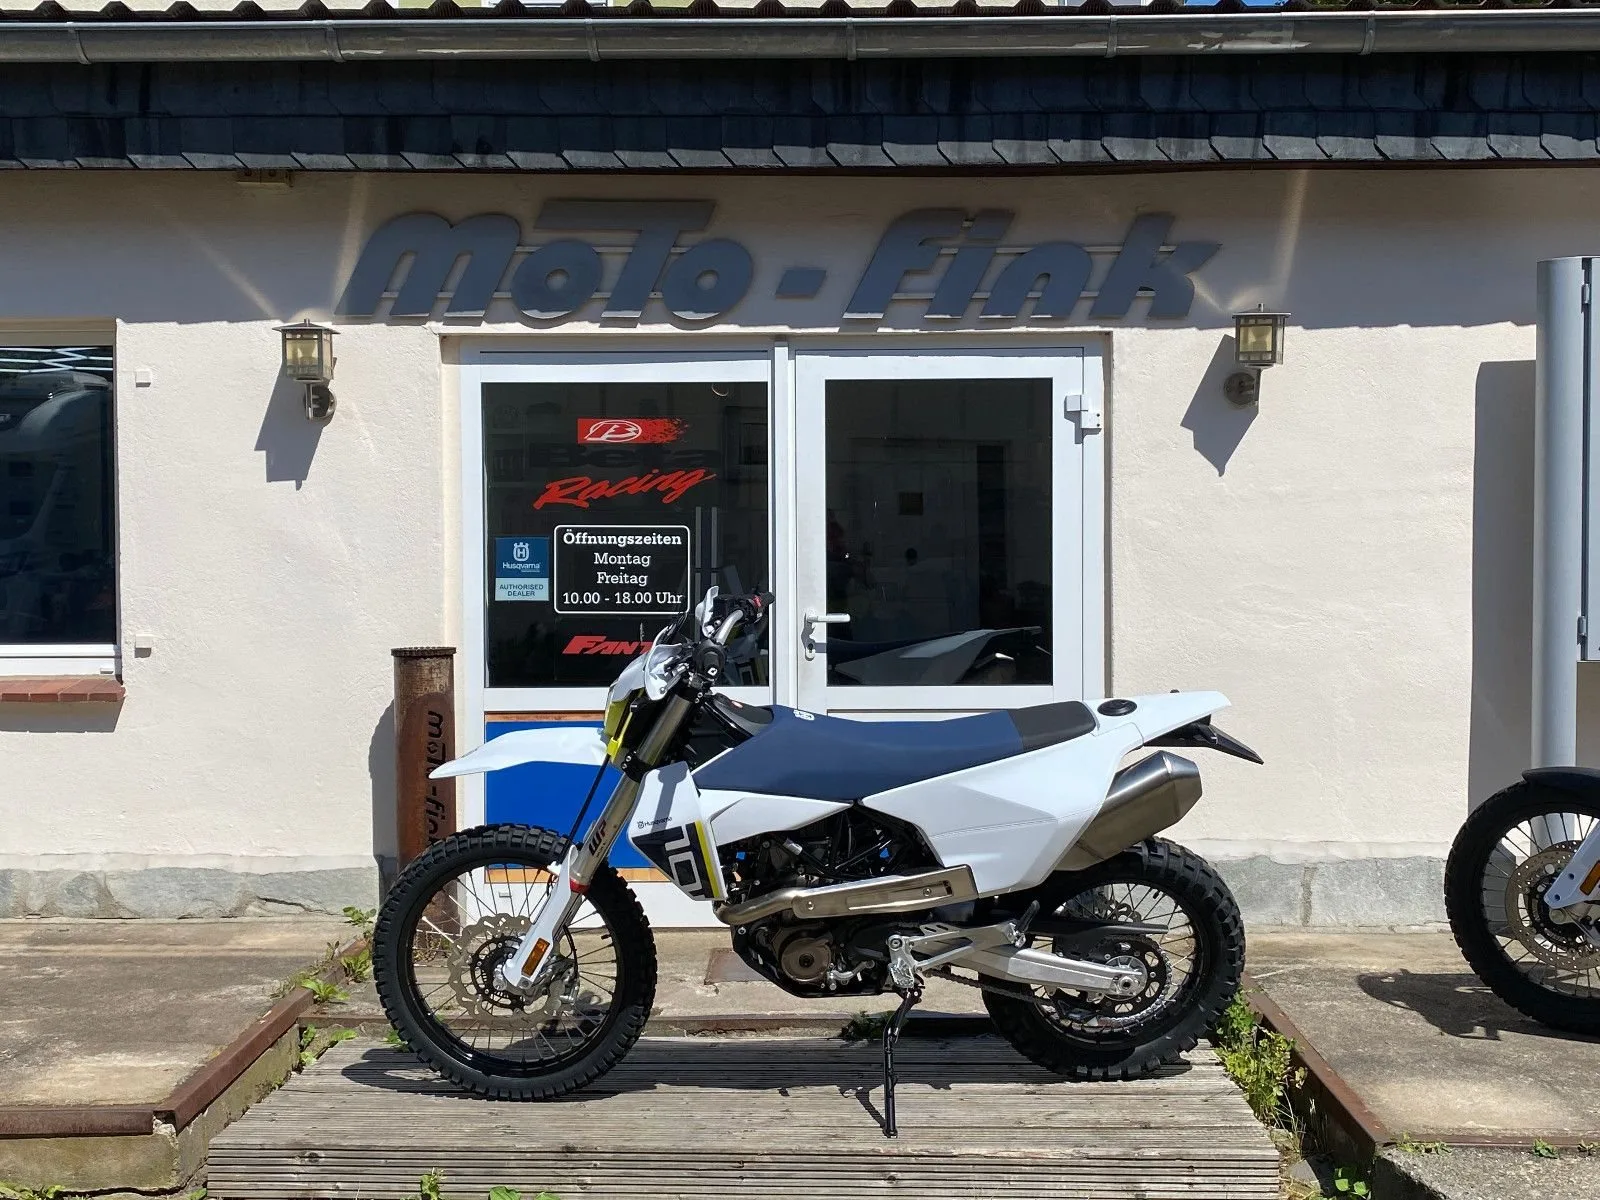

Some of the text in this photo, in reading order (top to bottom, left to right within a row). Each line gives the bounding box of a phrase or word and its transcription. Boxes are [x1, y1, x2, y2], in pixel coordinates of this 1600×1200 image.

[533, 469, 717, 510] Racing
[563, 529, 682, 547] Öffnungszeiten
[502, 562, 541, 570] Husqvarna
[594, 552, 651, 567] Montag
[596, 572, 648, 586] Freitag
[563, 592, 600, 604] 10.00
[614, 592, 652, 604] 18.00
[656, 592, 683, 604] Uhr
